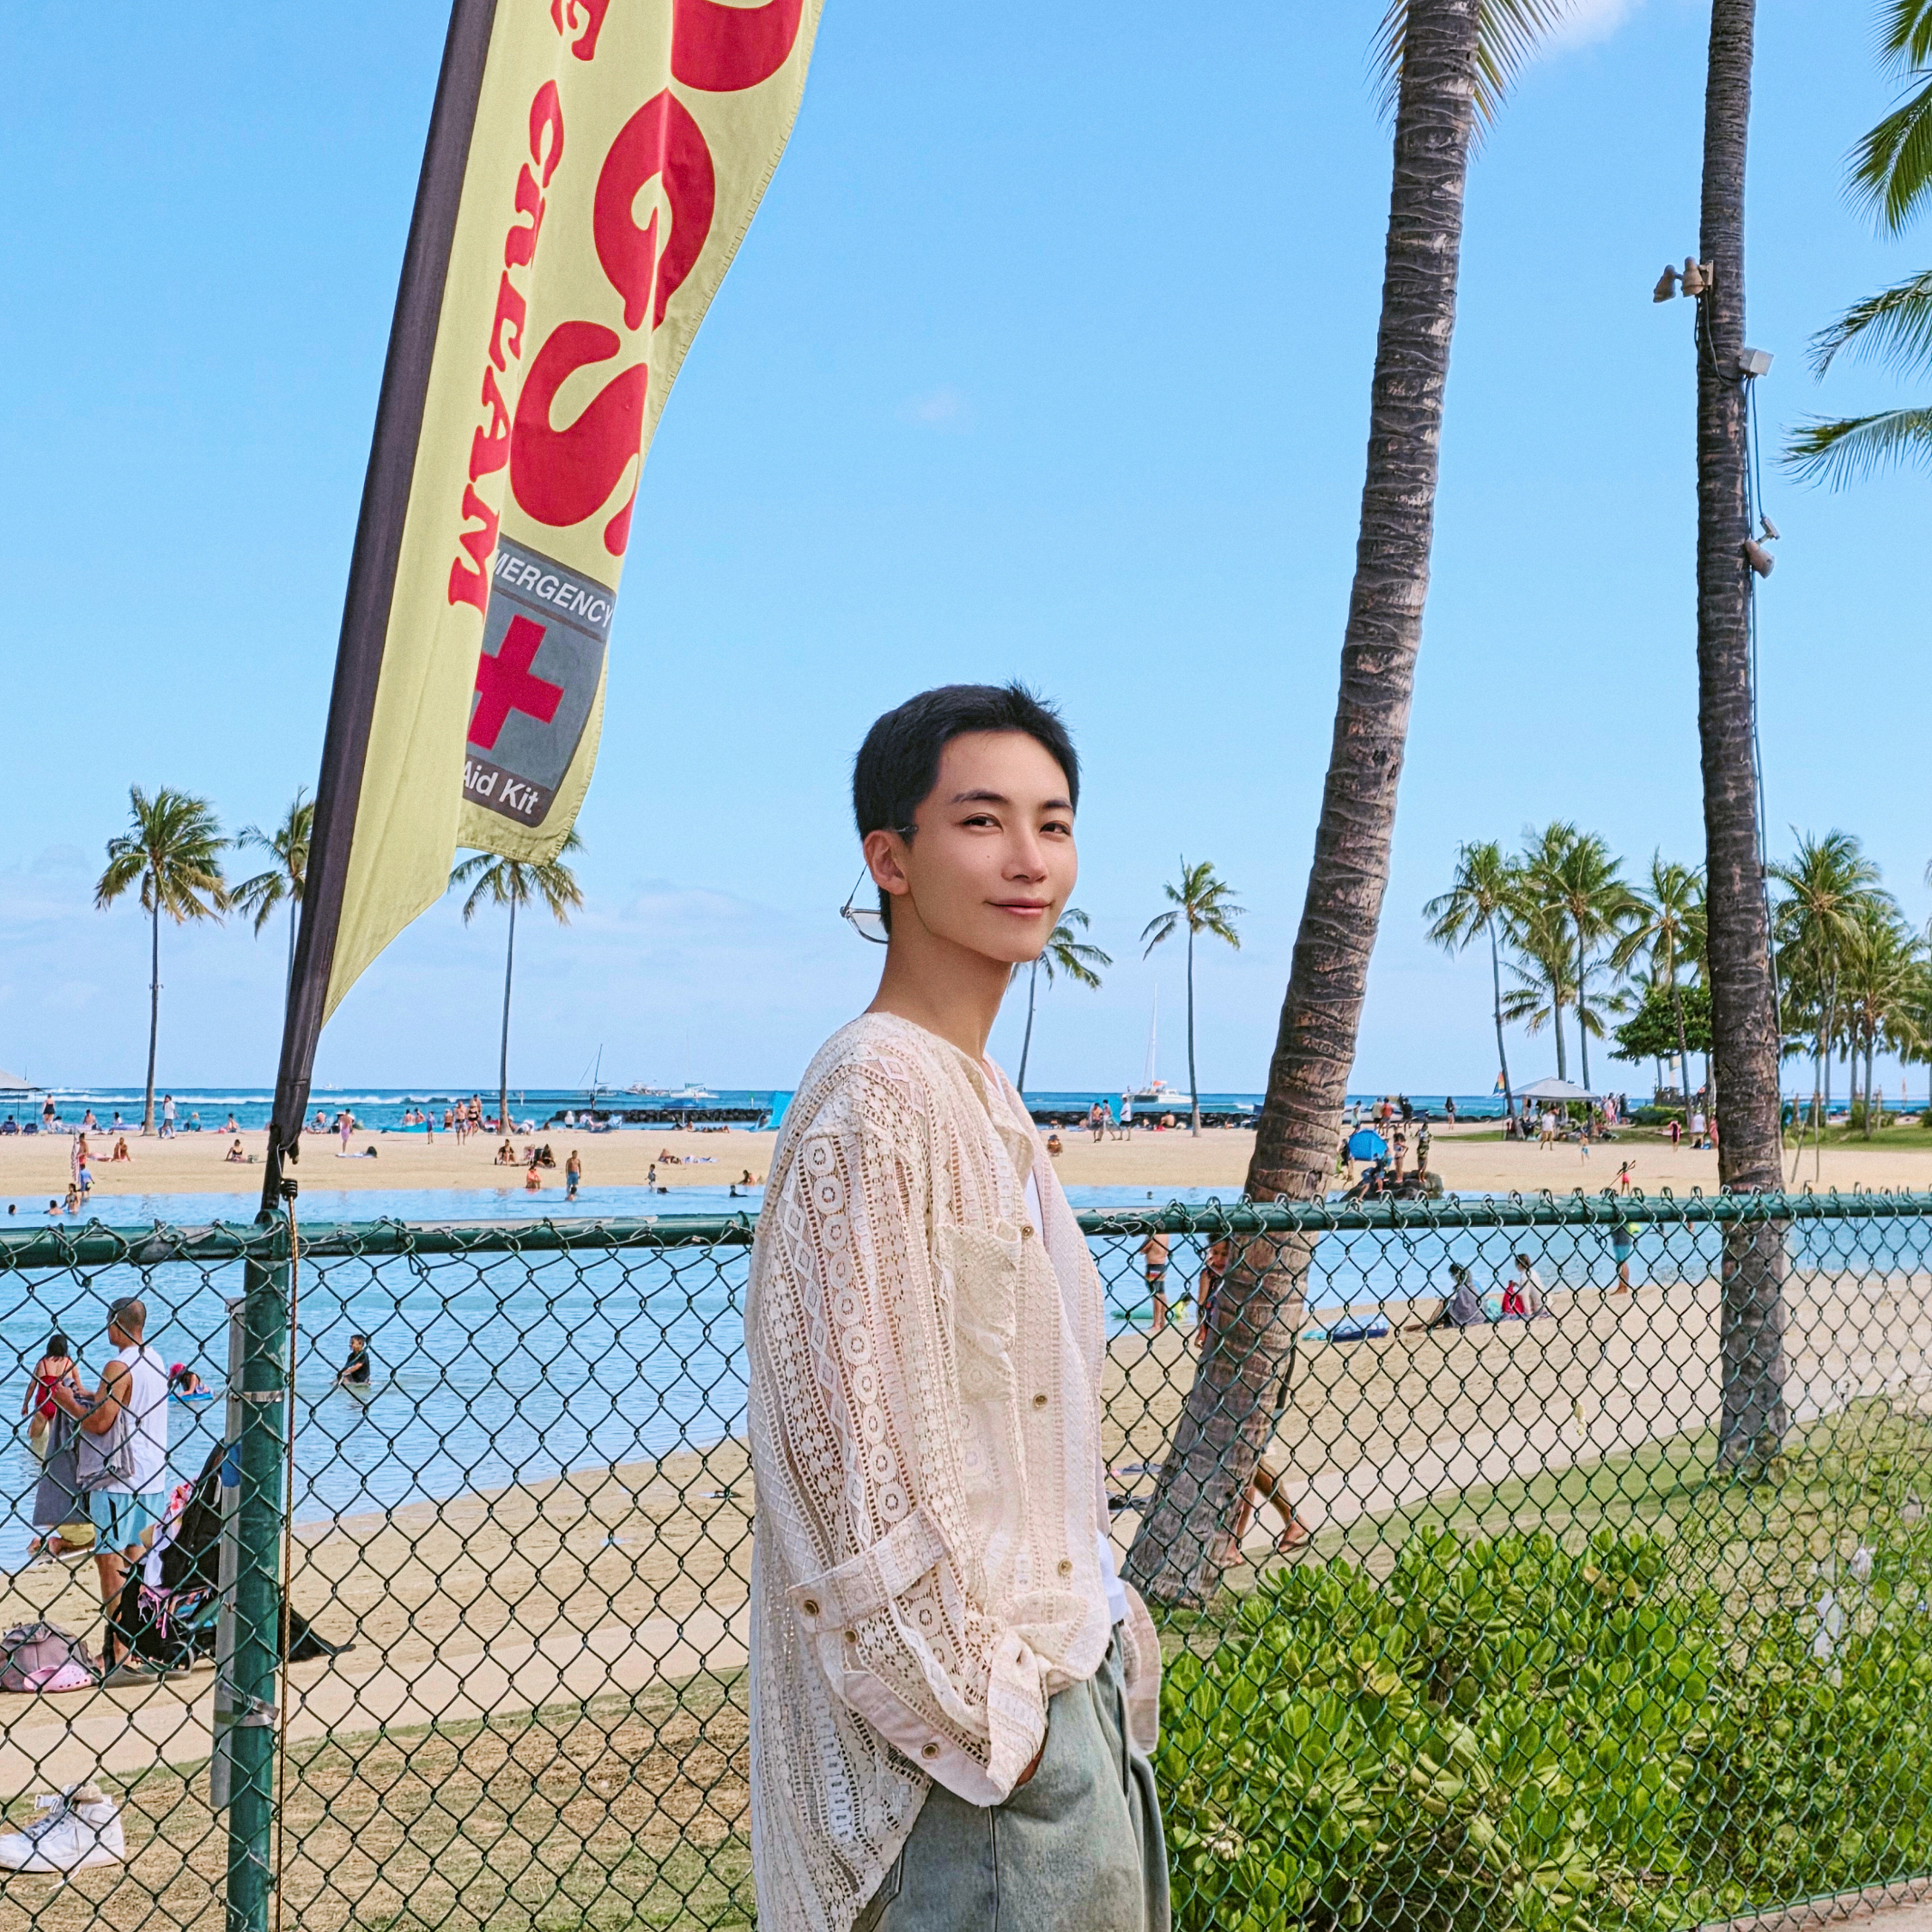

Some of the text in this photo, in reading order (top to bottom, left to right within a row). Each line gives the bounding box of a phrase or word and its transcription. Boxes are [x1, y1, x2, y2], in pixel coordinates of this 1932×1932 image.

[447, 79, 565, 622] CREAM
[464, 760, 538, 815] Aid Kit
